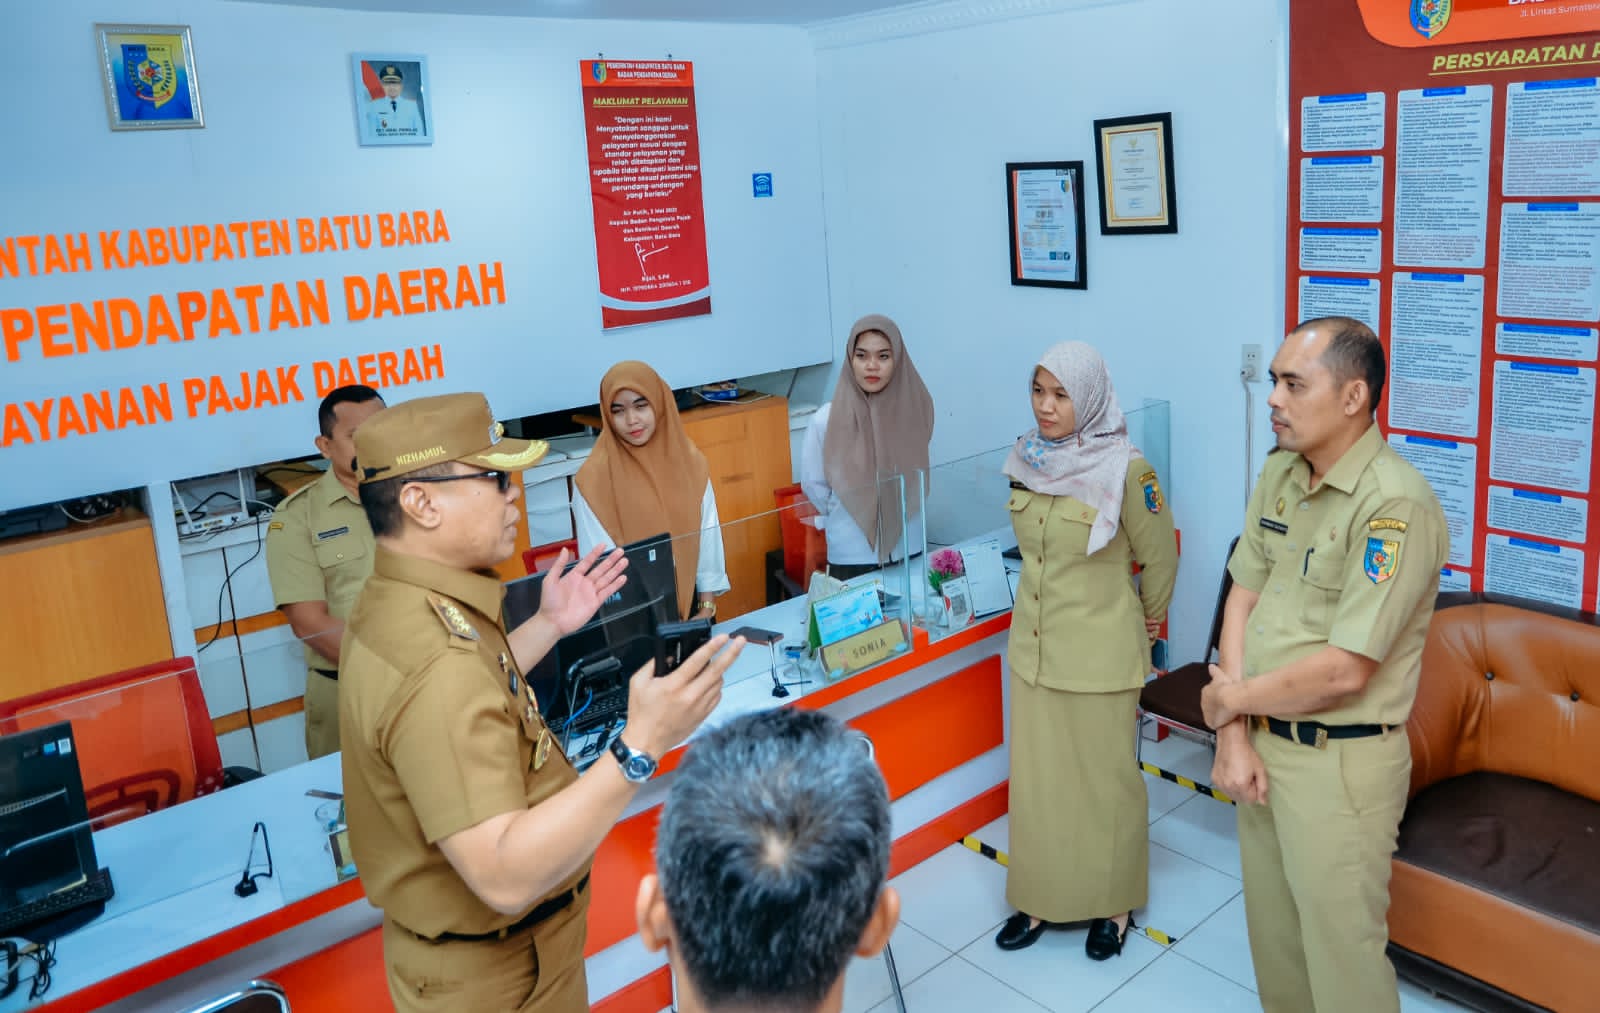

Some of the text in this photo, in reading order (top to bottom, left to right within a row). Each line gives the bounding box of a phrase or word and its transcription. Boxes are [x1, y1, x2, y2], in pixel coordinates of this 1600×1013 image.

[1432, 43, 1586, 70] PERSYARATAN
[641, 97, 688, 105] PELAYANAN
[596, 125, 638, 133] Menyatakan
[602, 142, 638, 150] pelayanan
[633, 149, 668, 157] pelayanan
[669, 149, 685, 157] yang
[631, 157, 667, 165] ditetapkan
[593, 168, 620, 176] apabila
[660, 173, 692, 182] peraturan
[98, 218, 292, 270] KABUPATEN
[296, 214, 372, 254] BATU
[378, 209, 451, 248] BARA
[0, 261, 506, 363] PENDAPATAN DAERAH
[0, 344, 444, 449] AYANAN PAJAK DAERAH
[852, 638, 886, 658] SONIA
